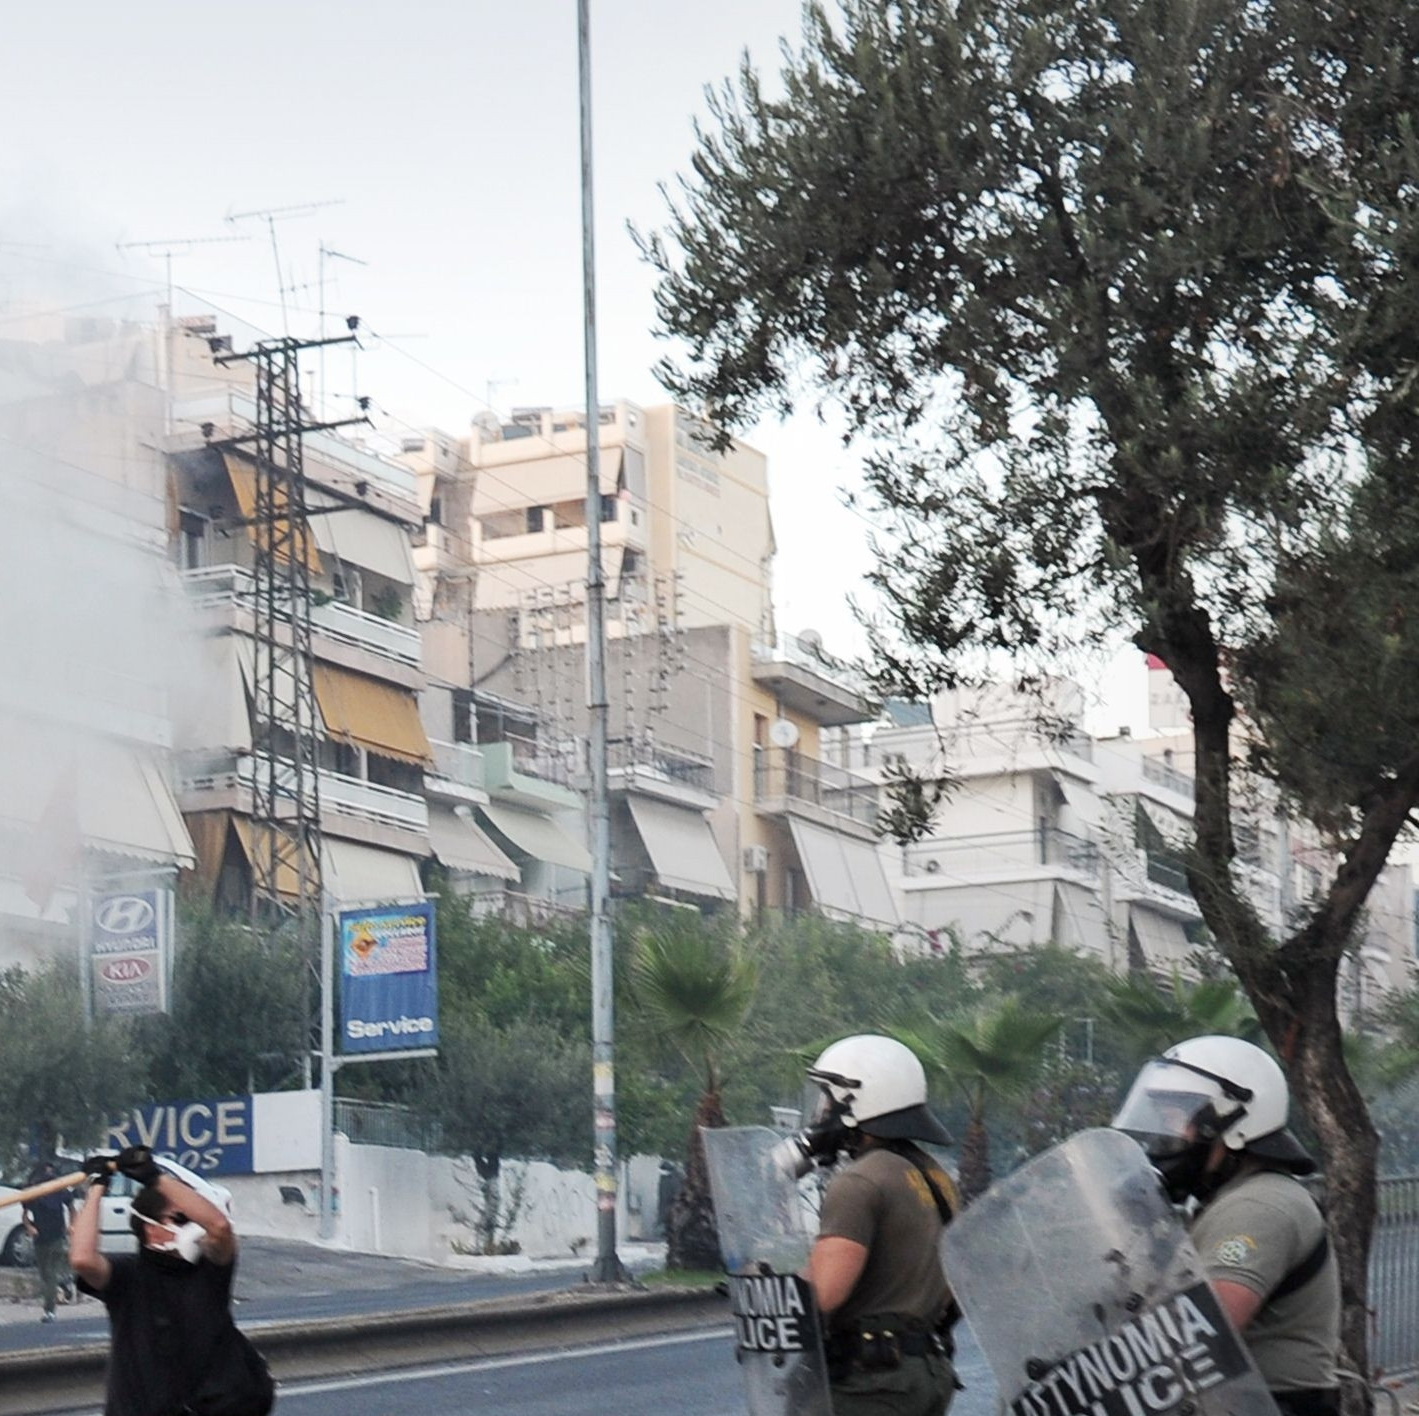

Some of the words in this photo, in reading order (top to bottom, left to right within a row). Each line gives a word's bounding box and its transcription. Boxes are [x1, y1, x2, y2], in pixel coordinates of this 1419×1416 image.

[109, 960, 143, 979] KIA
[346, 1015, 434, 1039] Service
[100, 1101, 247, 1150] RVICE
